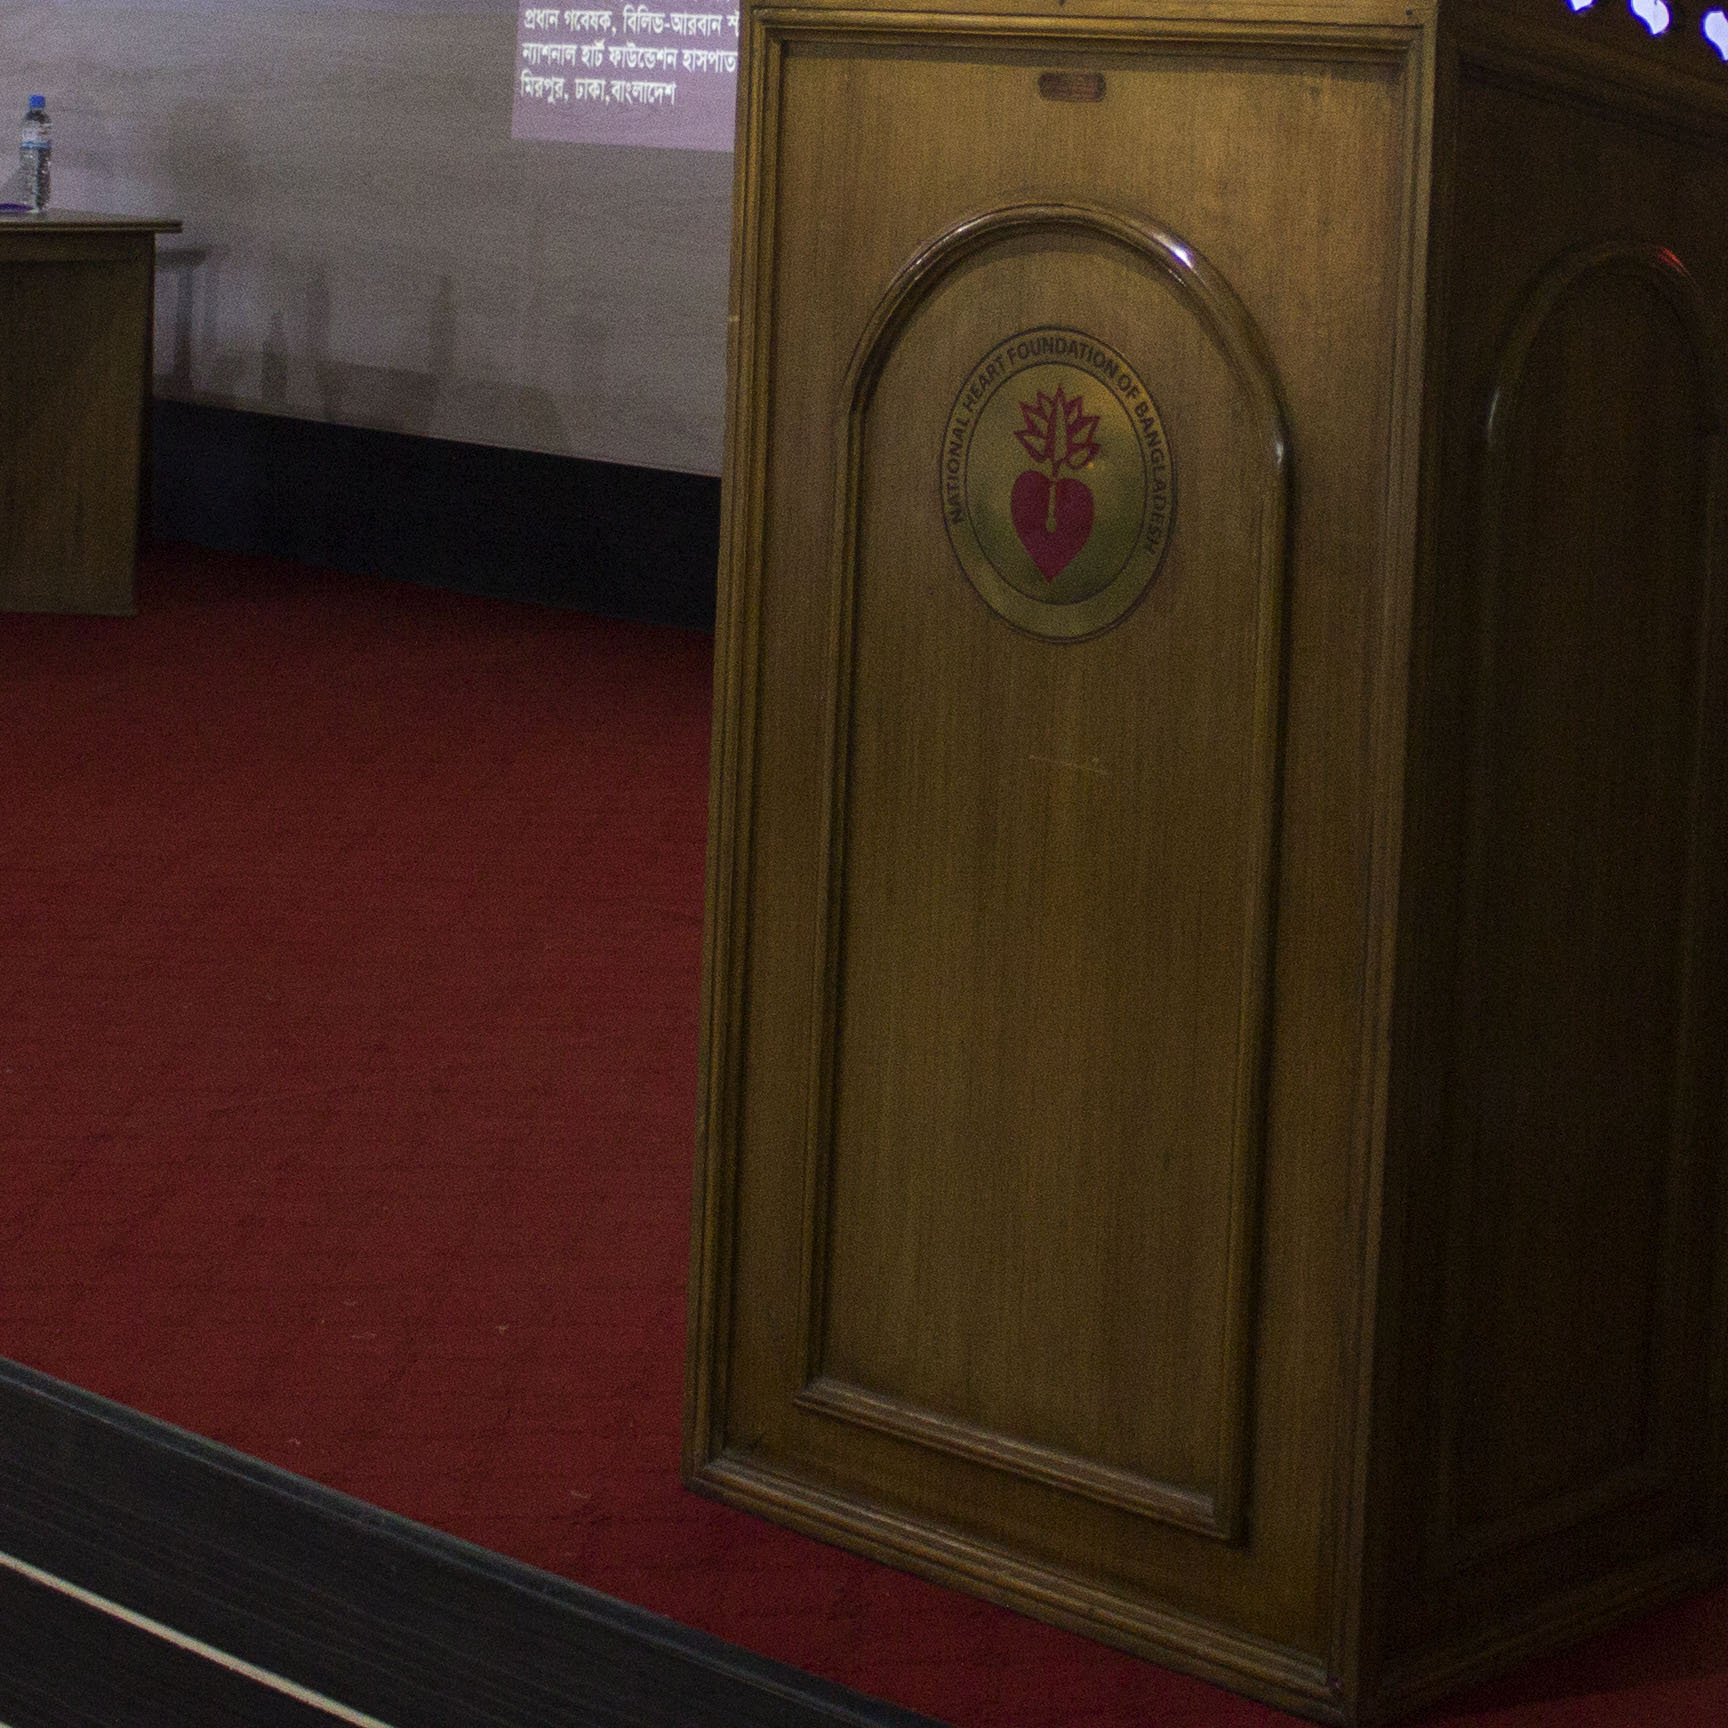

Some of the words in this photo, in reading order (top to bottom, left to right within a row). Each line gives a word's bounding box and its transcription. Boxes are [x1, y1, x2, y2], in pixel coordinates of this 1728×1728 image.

[682, 49, 739, 73] হাসপাত
[946, 416, 970, 523] NATIONAL
[962, 357, 1006, 413] HEART
[1007, 336, 1119, 379] FOUNDATION
[1117, 371, 1139, 400] OF
[1134, 401, 1167, 556] BANGLADESH
